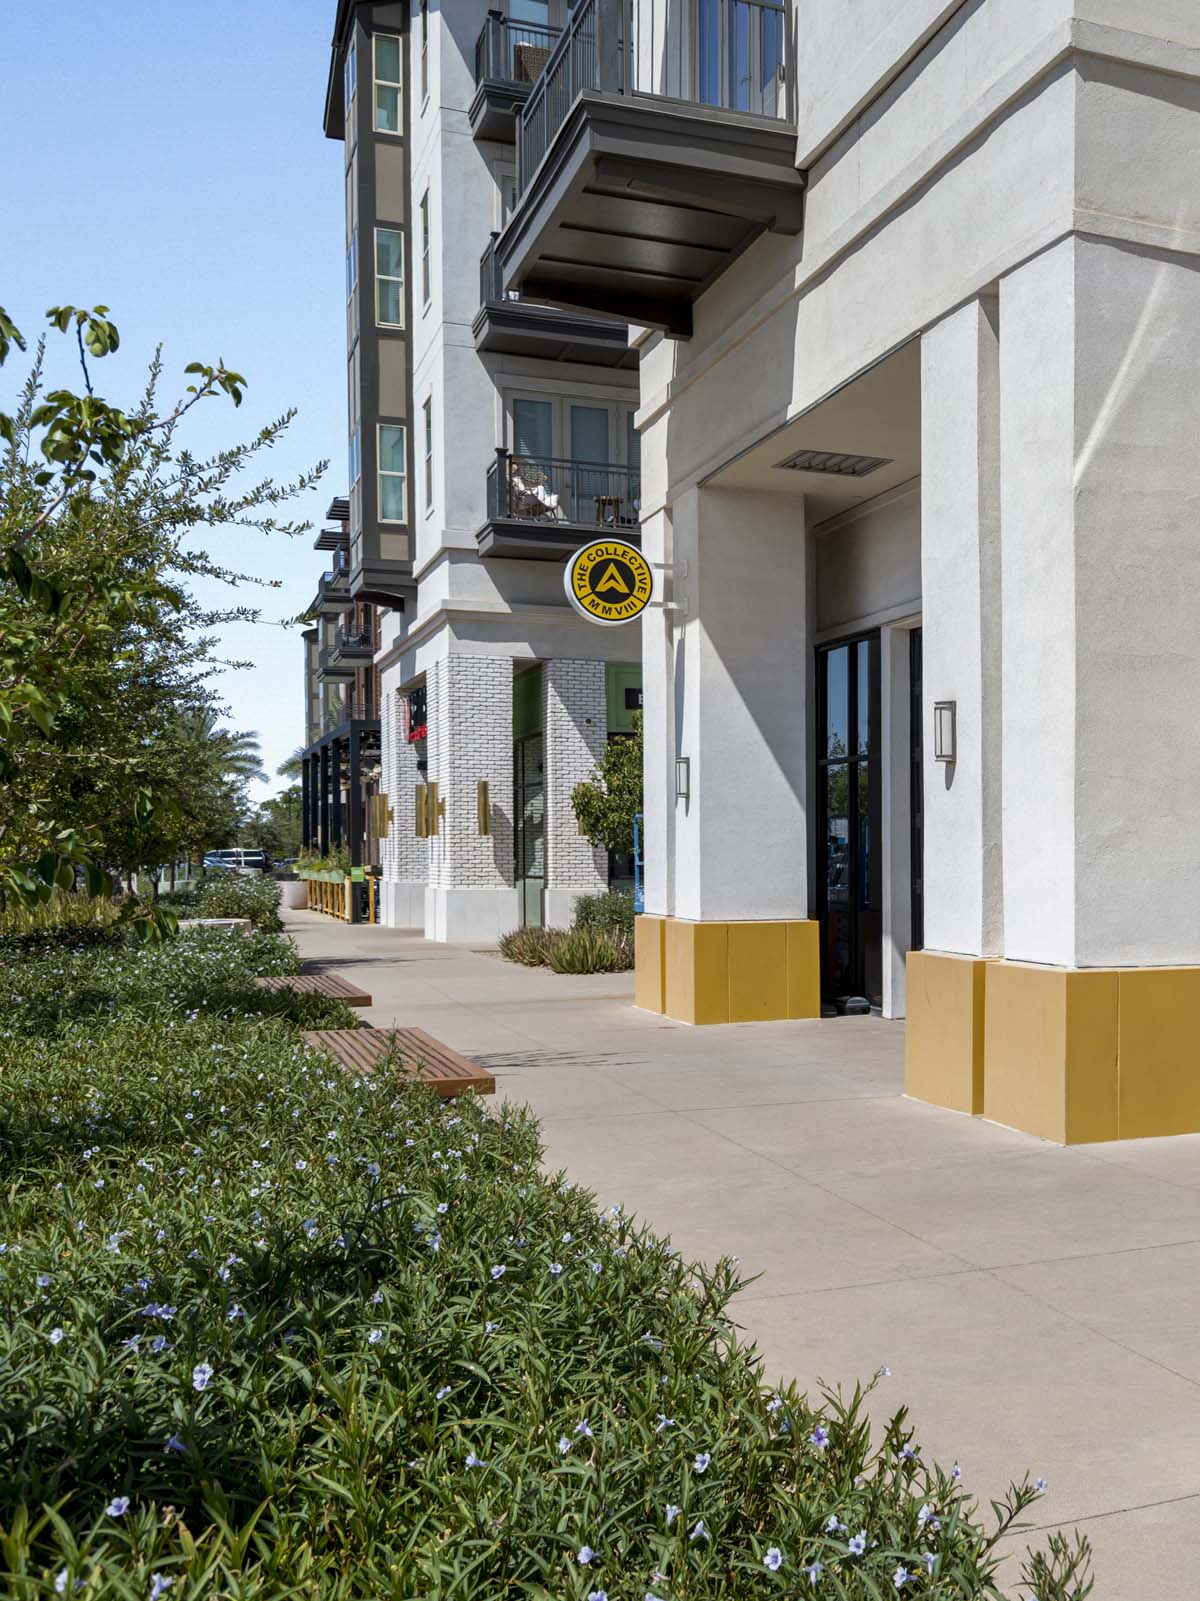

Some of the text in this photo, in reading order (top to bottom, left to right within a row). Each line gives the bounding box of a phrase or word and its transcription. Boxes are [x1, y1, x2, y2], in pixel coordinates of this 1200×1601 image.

[576, 546, 648, 595] THE COLLECTIVE
[588, 598, 637, 616] MMVIII
